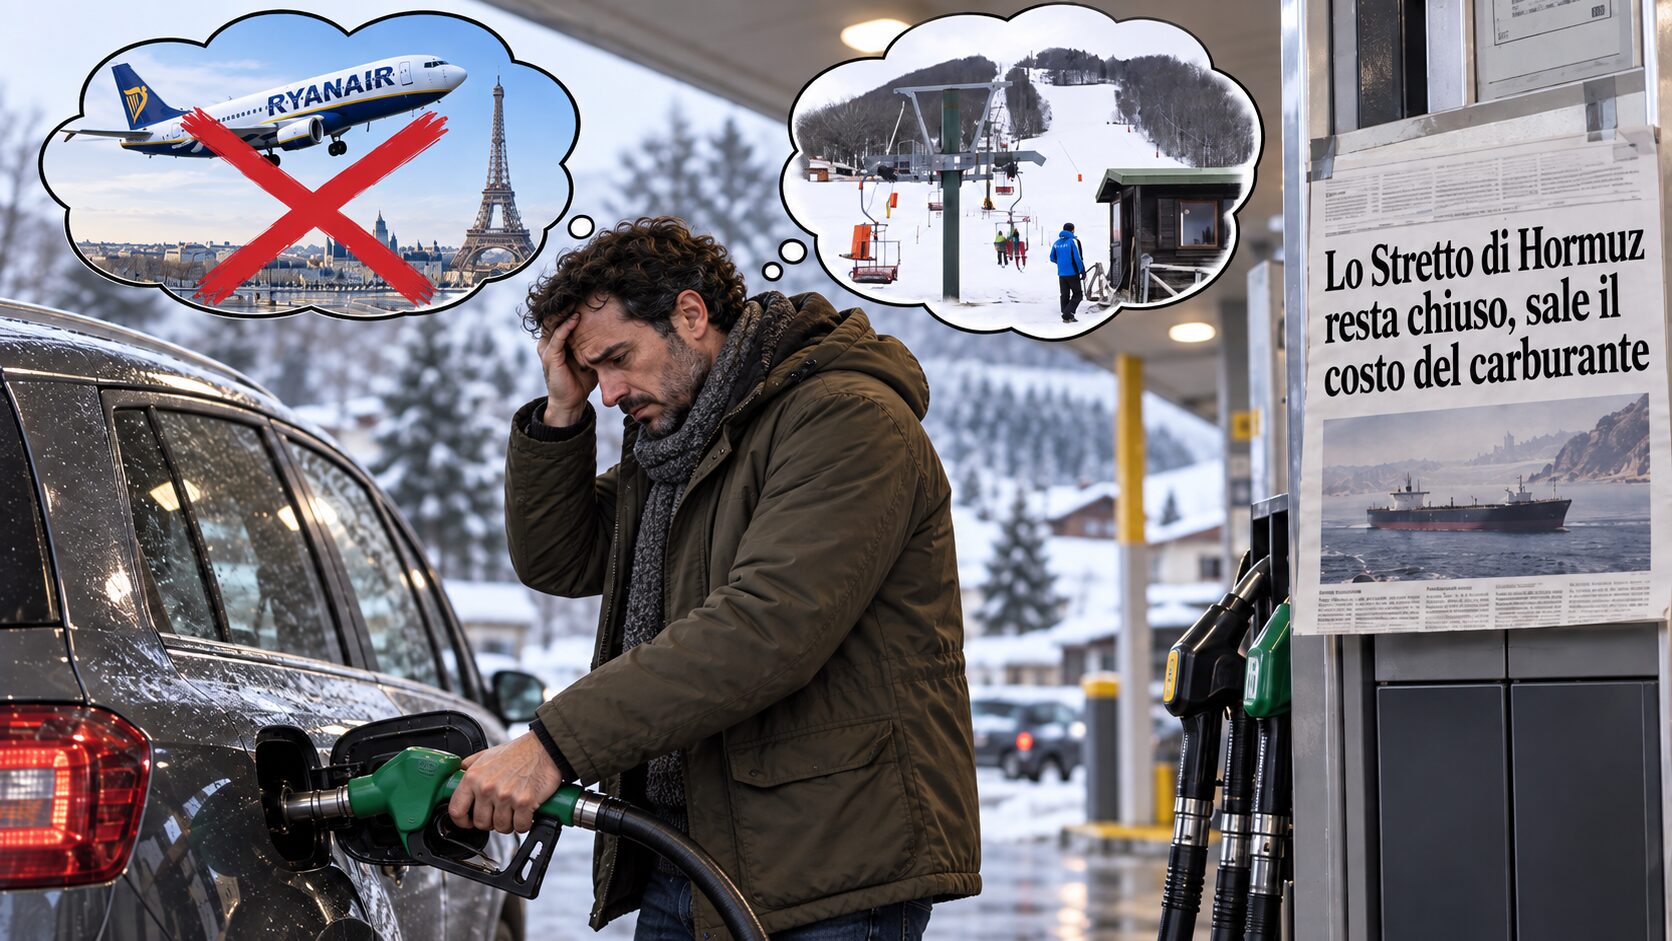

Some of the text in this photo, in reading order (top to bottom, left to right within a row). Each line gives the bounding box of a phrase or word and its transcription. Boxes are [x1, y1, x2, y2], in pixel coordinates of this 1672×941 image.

[267, 66, 395, 117] RYANAIR
[1325, 226, 1645, 292] Lo Stretto di Hormuz
[1325, 272, 1621, 343] resta chiuso, sale il
[1325, 333, 1650, 397] costo del carburante
